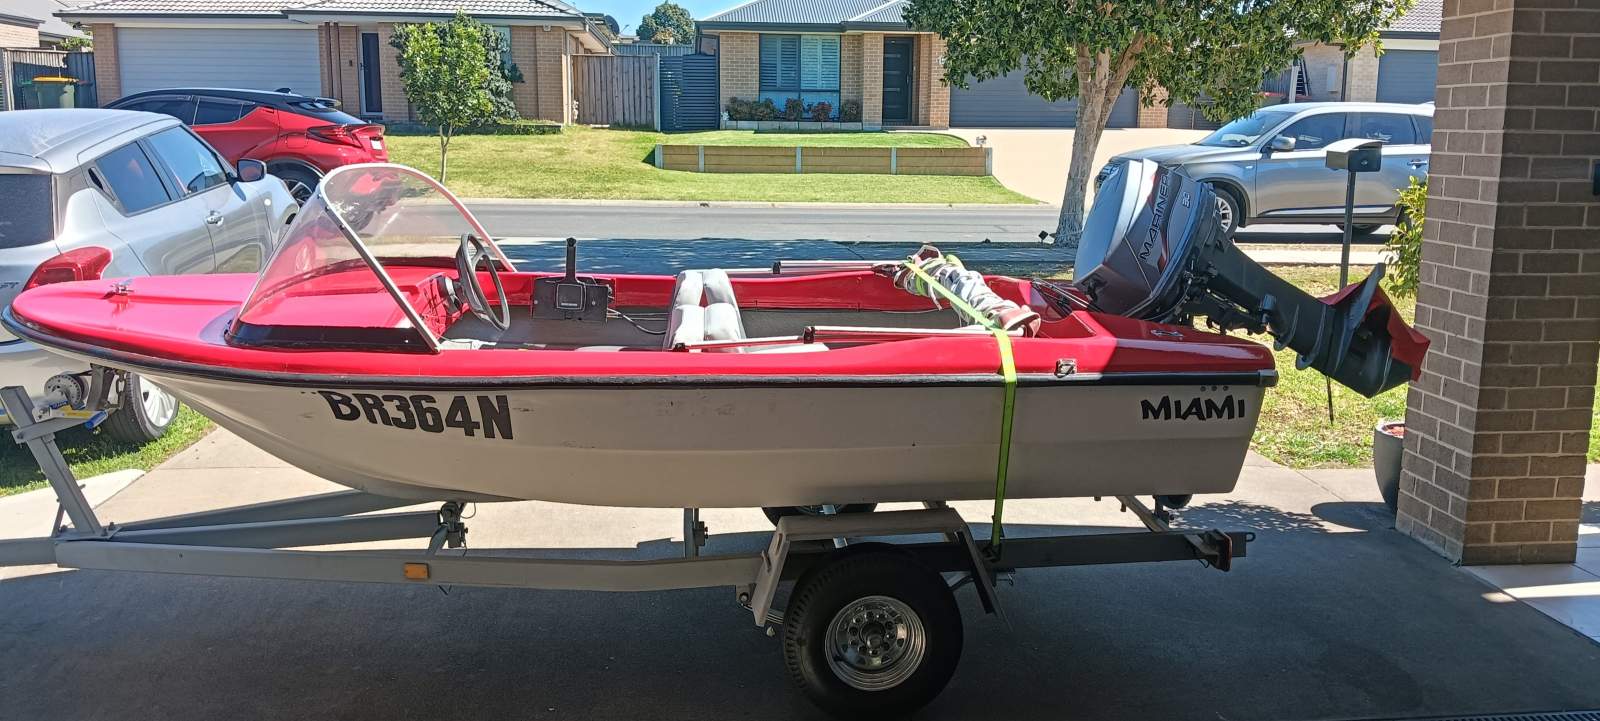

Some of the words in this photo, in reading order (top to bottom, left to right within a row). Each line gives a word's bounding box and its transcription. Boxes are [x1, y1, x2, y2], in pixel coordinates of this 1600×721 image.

[1139, 173, 1169, 260] MARINER
[317, 390, 514, 440] BR364N
[1140, 394, 1246, 421] MIAMI
